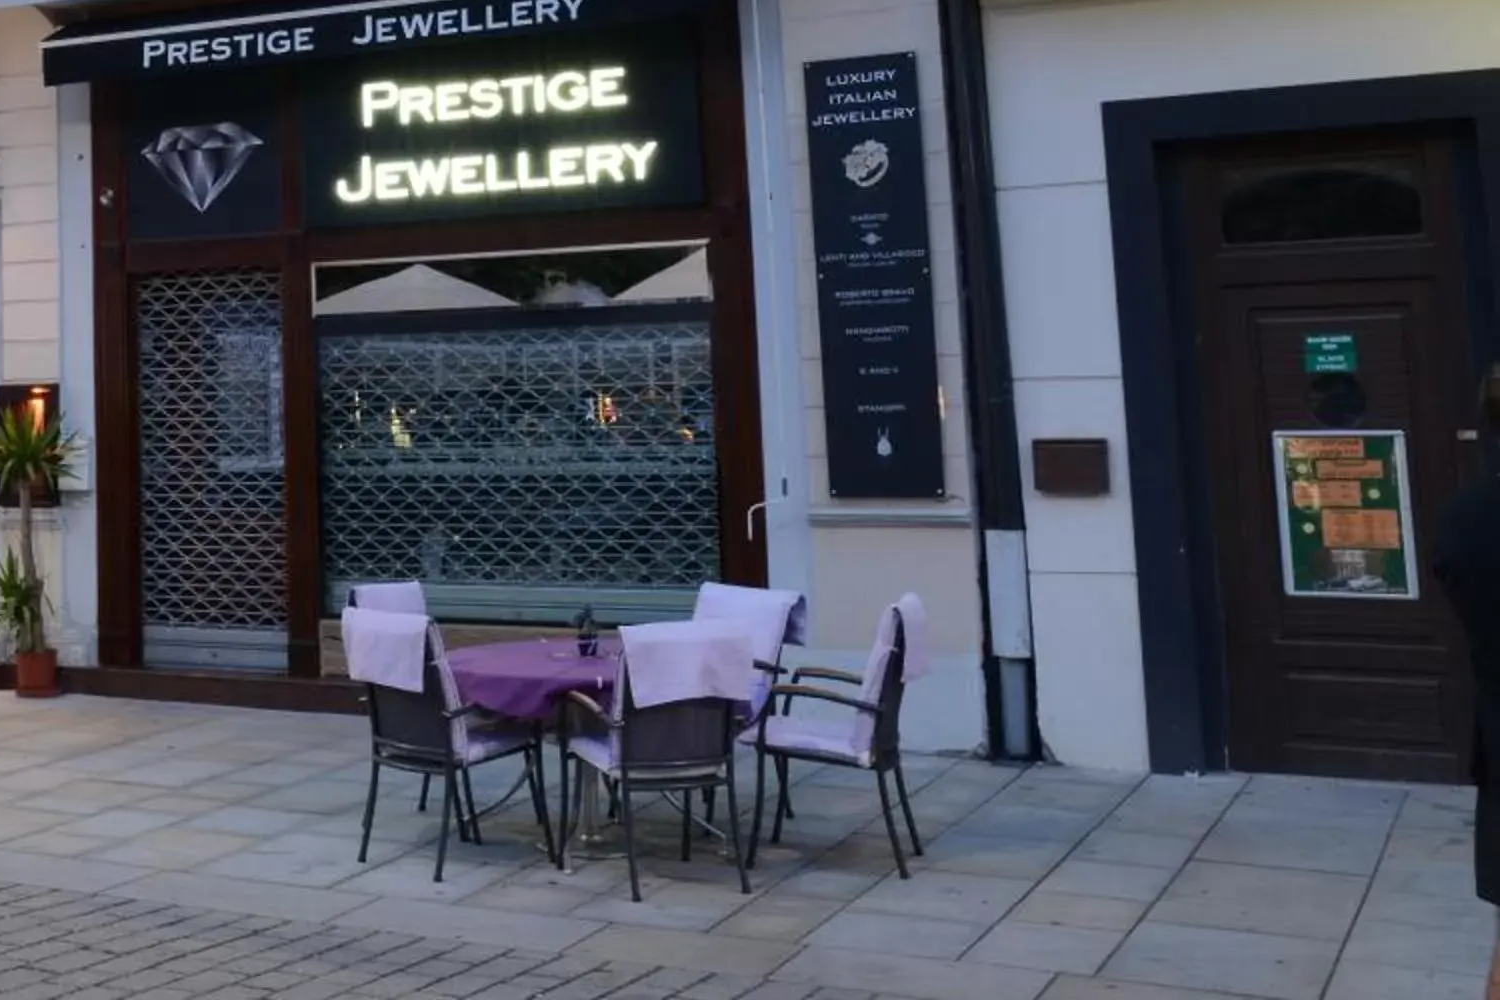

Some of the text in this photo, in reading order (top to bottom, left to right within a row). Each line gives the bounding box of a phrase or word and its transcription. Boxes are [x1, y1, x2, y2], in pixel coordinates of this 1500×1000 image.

[142, 27, 315, 68] PRESTIGE
[825, 69, 897, 87] LUXURY
[360, 66, 629, 127] PRESTIGE
[829, 89, 897, 105] ITALIAN
[811, 107, 916, 127] JEWELLERY
[335, 141, 658, 204] JEWELLERY
